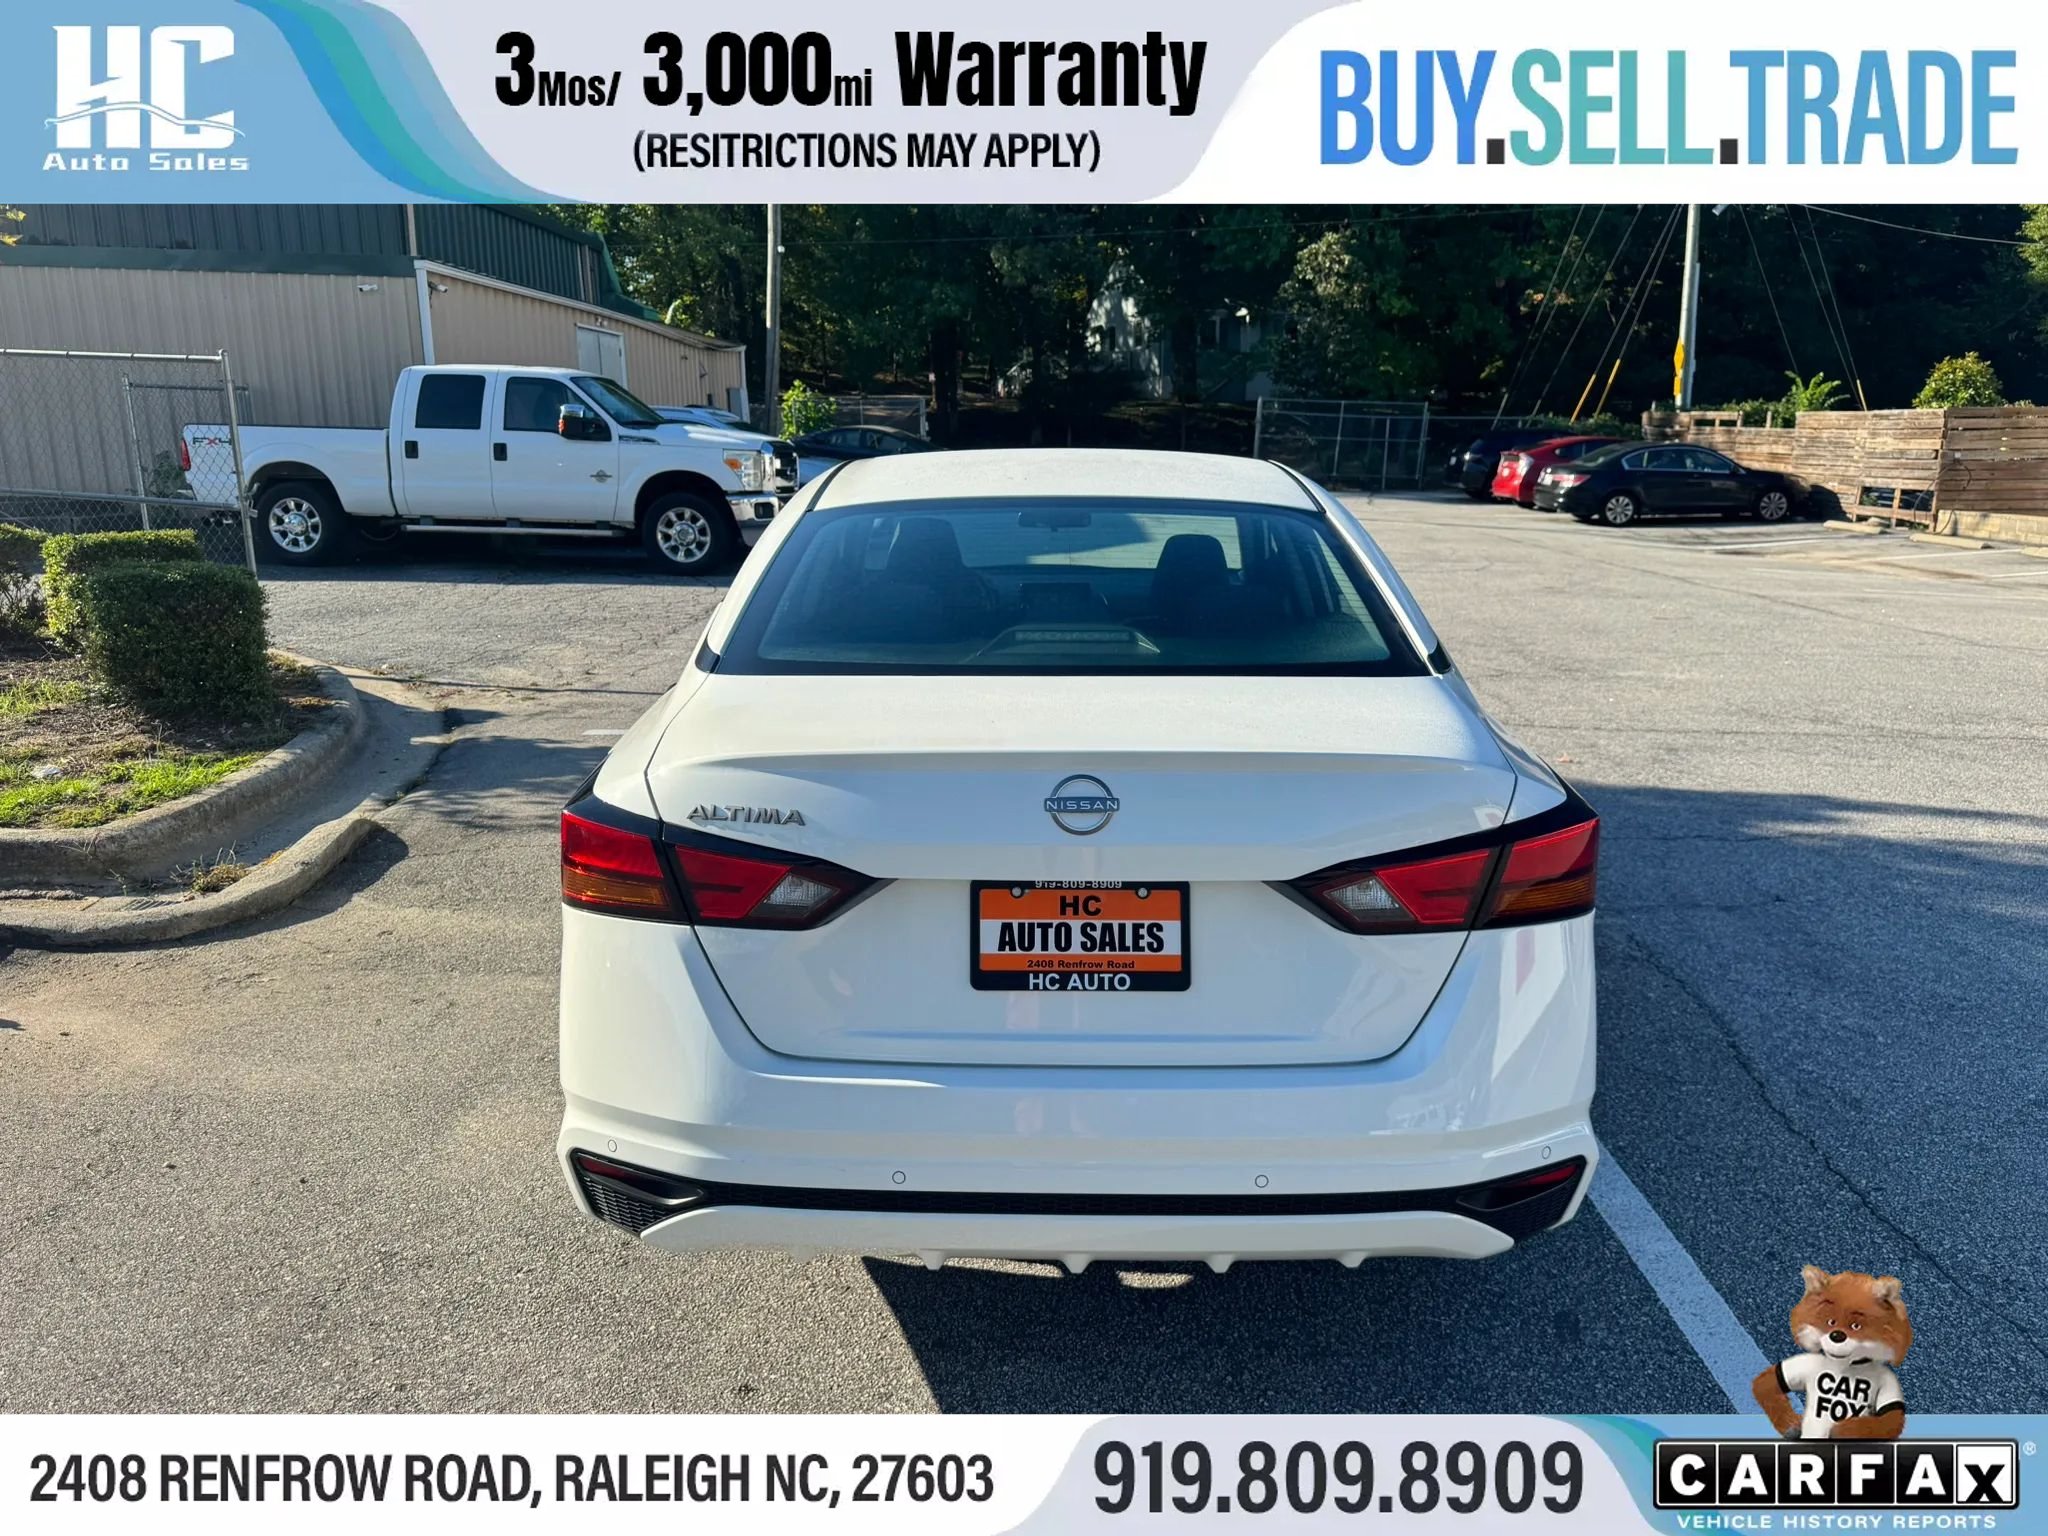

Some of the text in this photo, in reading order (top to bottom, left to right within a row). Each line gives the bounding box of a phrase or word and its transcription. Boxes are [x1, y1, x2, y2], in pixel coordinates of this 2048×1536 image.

[1046, 800, 1119, 812] NISSAN
[686, 804, 807, 826] ALTIMA
[1035, 880, 1123, 889] 919-809-8909
[1059, 895, 1102, 916] HC
[997, 922, 1165, 953] AUTO SALES
[1027, 959, 1135, 969] 2408 Renfrow Road
[1028, 973, 1131, 990] HC AUTO
